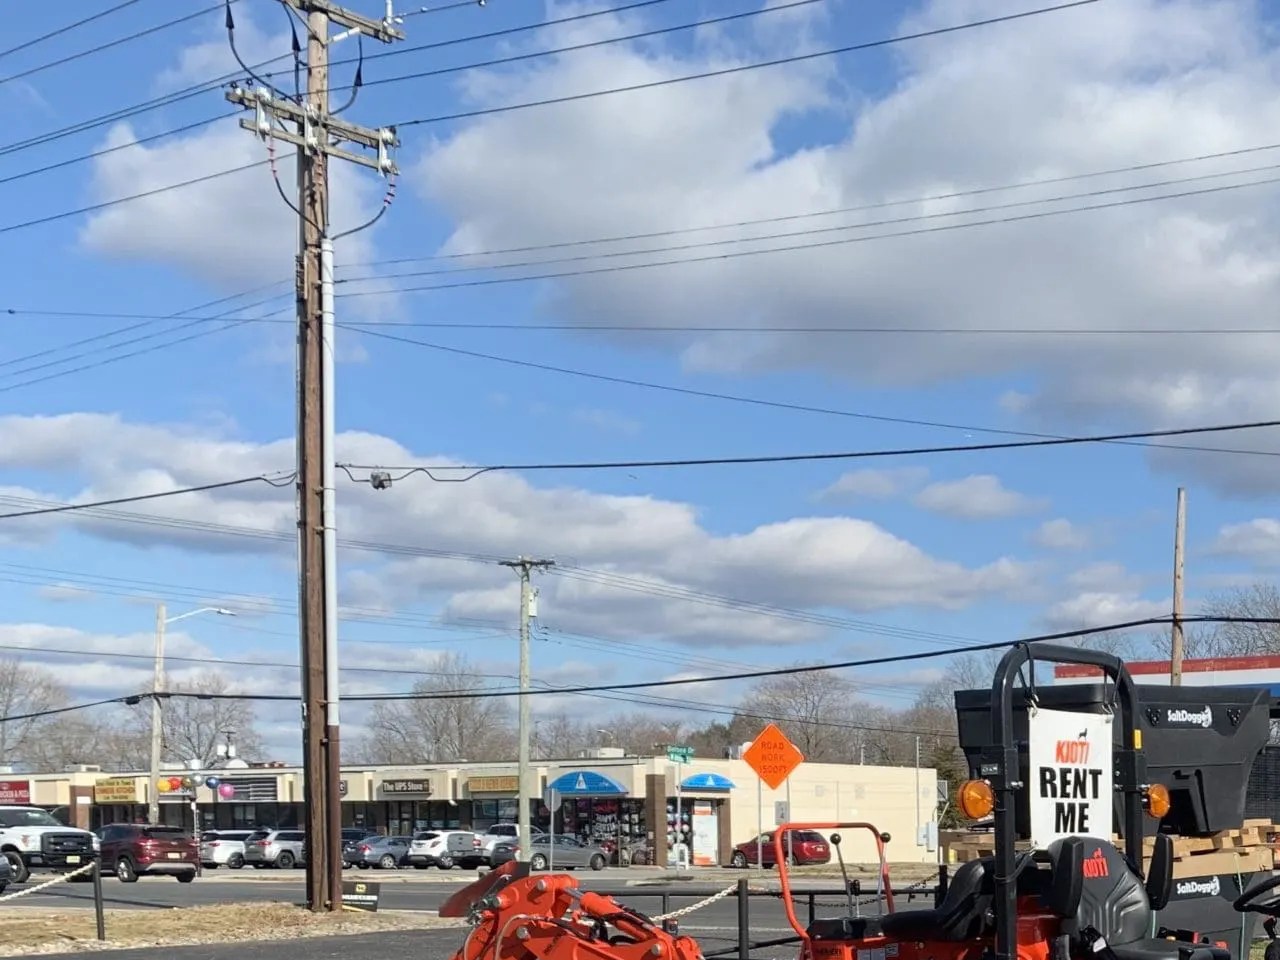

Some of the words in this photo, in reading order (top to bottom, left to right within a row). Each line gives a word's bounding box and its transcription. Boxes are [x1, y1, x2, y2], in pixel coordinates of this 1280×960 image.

[761, 741, 784, 750] ROAD
[1055, 740, 1090, 764] KIOTI
[761, 753, 785, 762] WORK
[1039, 767, 1102, 799] RENT
[1055, 803, 1089, 833] ME
[1083, 857, 1109, 878] KIOTI
